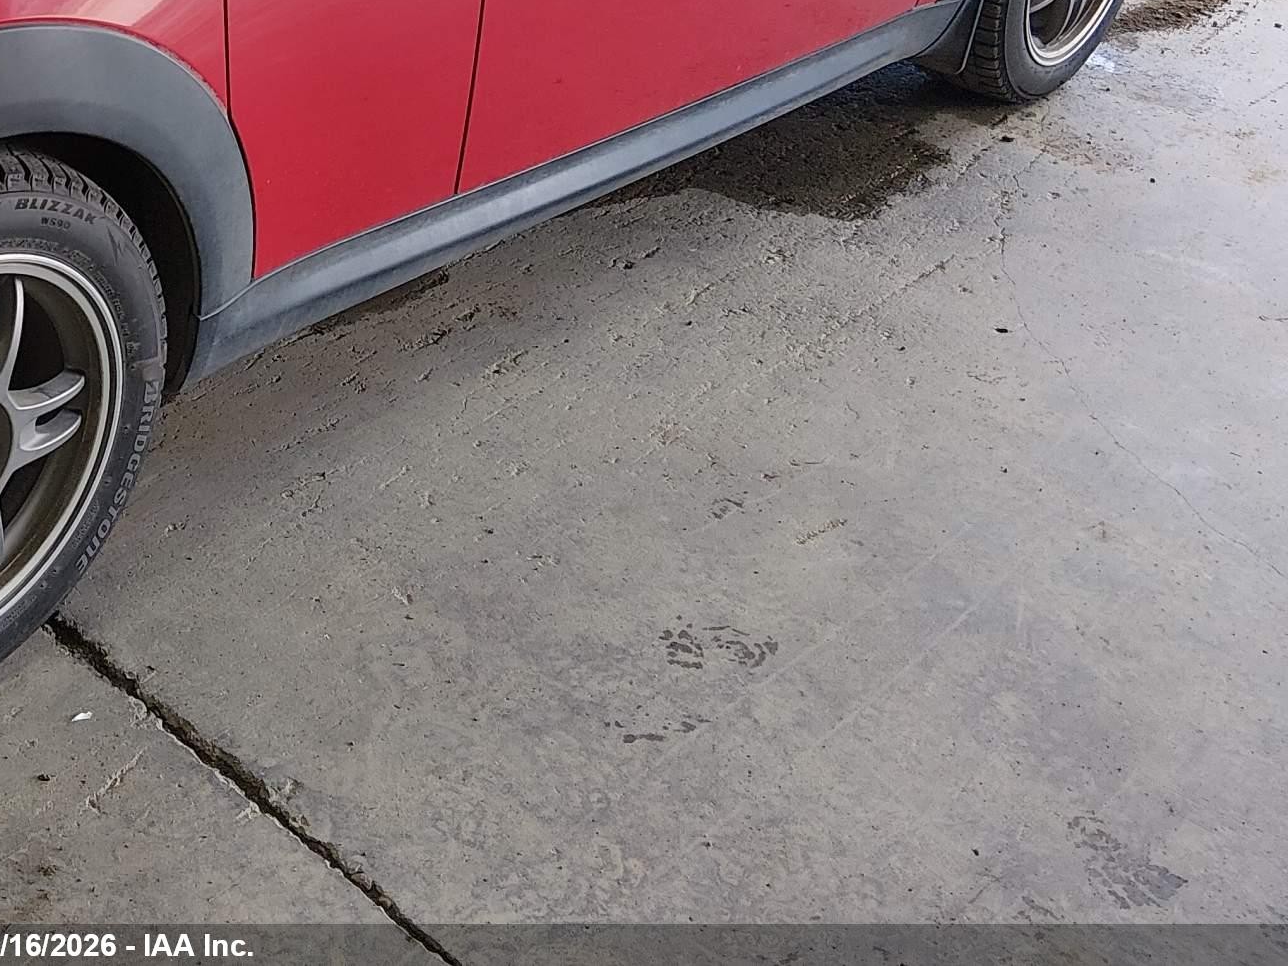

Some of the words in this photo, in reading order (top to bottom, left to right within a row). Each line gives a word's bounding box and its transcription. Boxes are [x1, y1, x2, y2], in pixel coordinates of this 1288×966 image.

[14, 198, 98, 225] BLIZZAK
[40, 216, 72, 231] WS90
[75, 381, 160, 575] BRIDGESTONE
